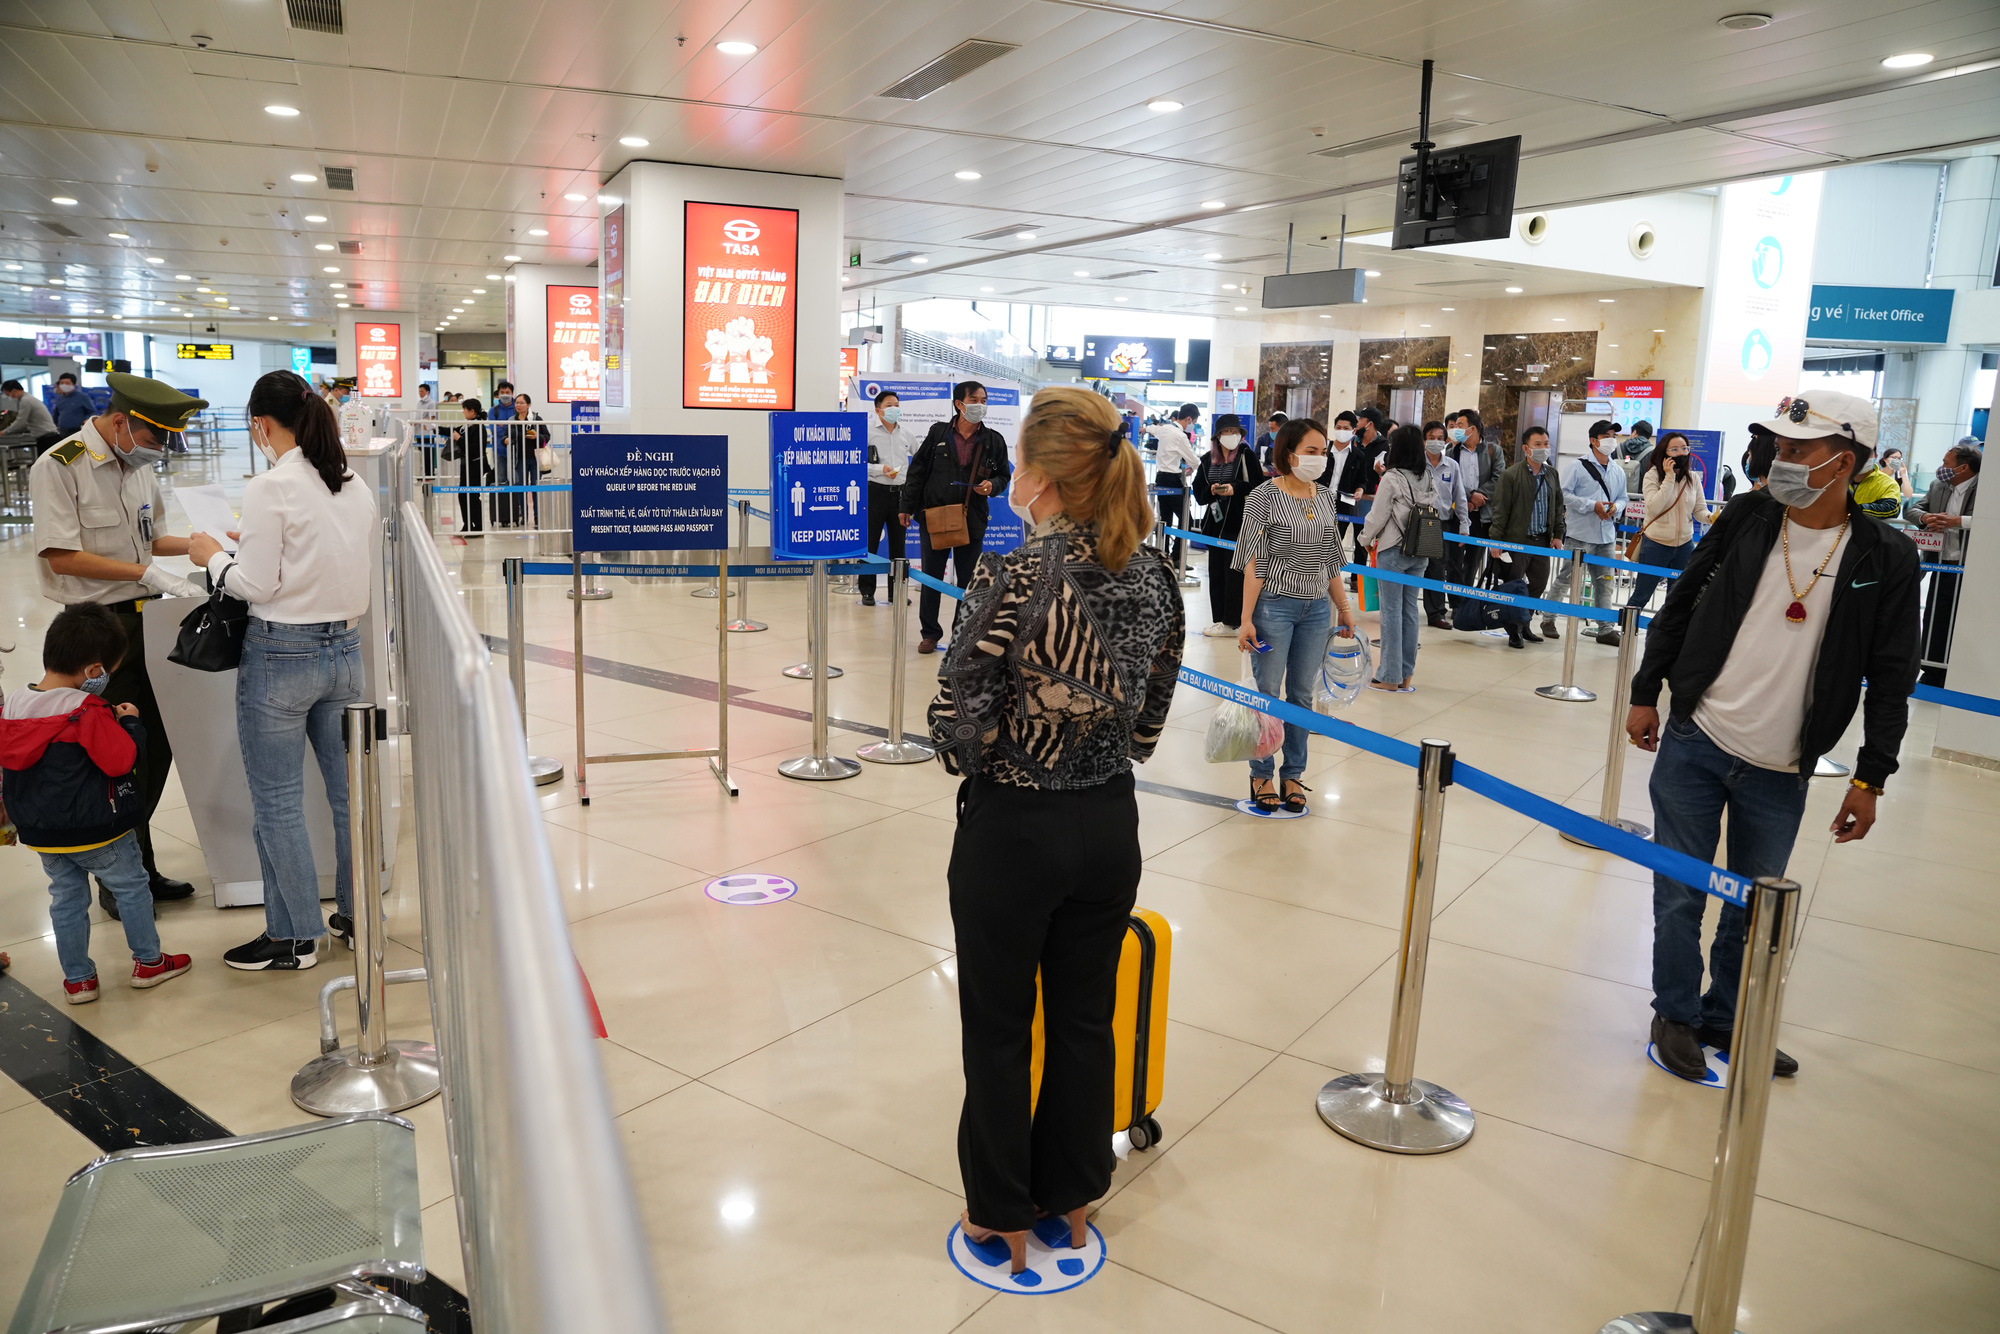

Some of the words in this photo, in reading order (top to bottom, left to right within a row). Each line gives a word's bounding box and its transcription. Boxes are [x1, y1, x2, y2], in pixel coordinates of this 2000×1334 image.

[722, 243, 759, 256] TASA
[698, 266, 714, 279] VIỆT
[716, 268, 734, 279] NAM
[694, 281, 733, 306] ĐẠI
[737, 284, 786, 308] DỊCH
[569, 308, 592, 316] TASA
[1826, 304, 1842, 318] vé
[1854, 308, 1888, 320] Ticket
[1890, 309, 1924, 322] Office
[794, 424, 805, 443] QUÝ
[806, 424, 825, 441] KHÁCH
[826, 427, 835, 441] VUI
[836, 424, 851, 441] LÒNG
[626, 447, 642, 461] ĐỀ
[645, 452, 674, 463] NGHỊ
[784, 446, 795, 465] XẾP
[796, 448, 811, 465] HÀNG
[812, 447, 827, 464] CÁCH
[829, 450, 844, 464] NHAU
[845, 450, 849, 464] 2
[850, 447, 861, 464] MÉT
[580, 466, 594, 477] QUÝ
[595, 465, 618, 476] KHÁCH
[620, 465, 632, 476] XẾP
[634, 466, 652, 476] HÀNG
[654, 468, 667, 479] DỌC
[669, 466, 691, 477] TRƯỚC
[692, 468, 709, 478] VẠCH
[711, 465, 720, 476] ĐỎ
[606, 483, 626, 492] QUEUE
[637, 483, 658, 491] BEFORE
[660, 483, 670, 491] THE
[672, 483, 683, 491] RED
[580, 506, 596, 518] XUẤT
[597, 507, 613, 518] TRÌNH
[615, 506, 627, 519] THẺ,
[628, 507, 637, 519] VÉ,
[638, 506, 651, 518] GIẤY
[652, 507, 660, 517] TỜ
[673, 507, 687, 517] THÂN
[688, 507, 699, 517] LÊN
[712, 508, 723, 517] BAY
[591, 525, 613, 534] PRESENT
[614, 525, 631, 534] TICKET,
[633, 524, 659, 533] BOARDING
[660, 524, 673, 532] PASS
[674, 524, 685, 532] AND
[792, 531, 814, 542] KEEP
[816, 529, 859, 542] DISTANCE
[610, 566, 625, 574] NINH
[626, 566, 643, 574] HÀNG
[644, 566, 664, 574] KHÔNG
[666, 567, 676, 575] NỘI
[1463, 588, 1487, 597] AVIATION
[1488, 592, 1515, 603] SECURITY
[1178, 669, 1188, 682] NOI
[1190, 674, 1201, 686] BAI
[1202, 678, 1234, 699] AVIATION
[1235, 690, 1270, 711] SECURITY
[1709, 871, 1739, 898] NOI
